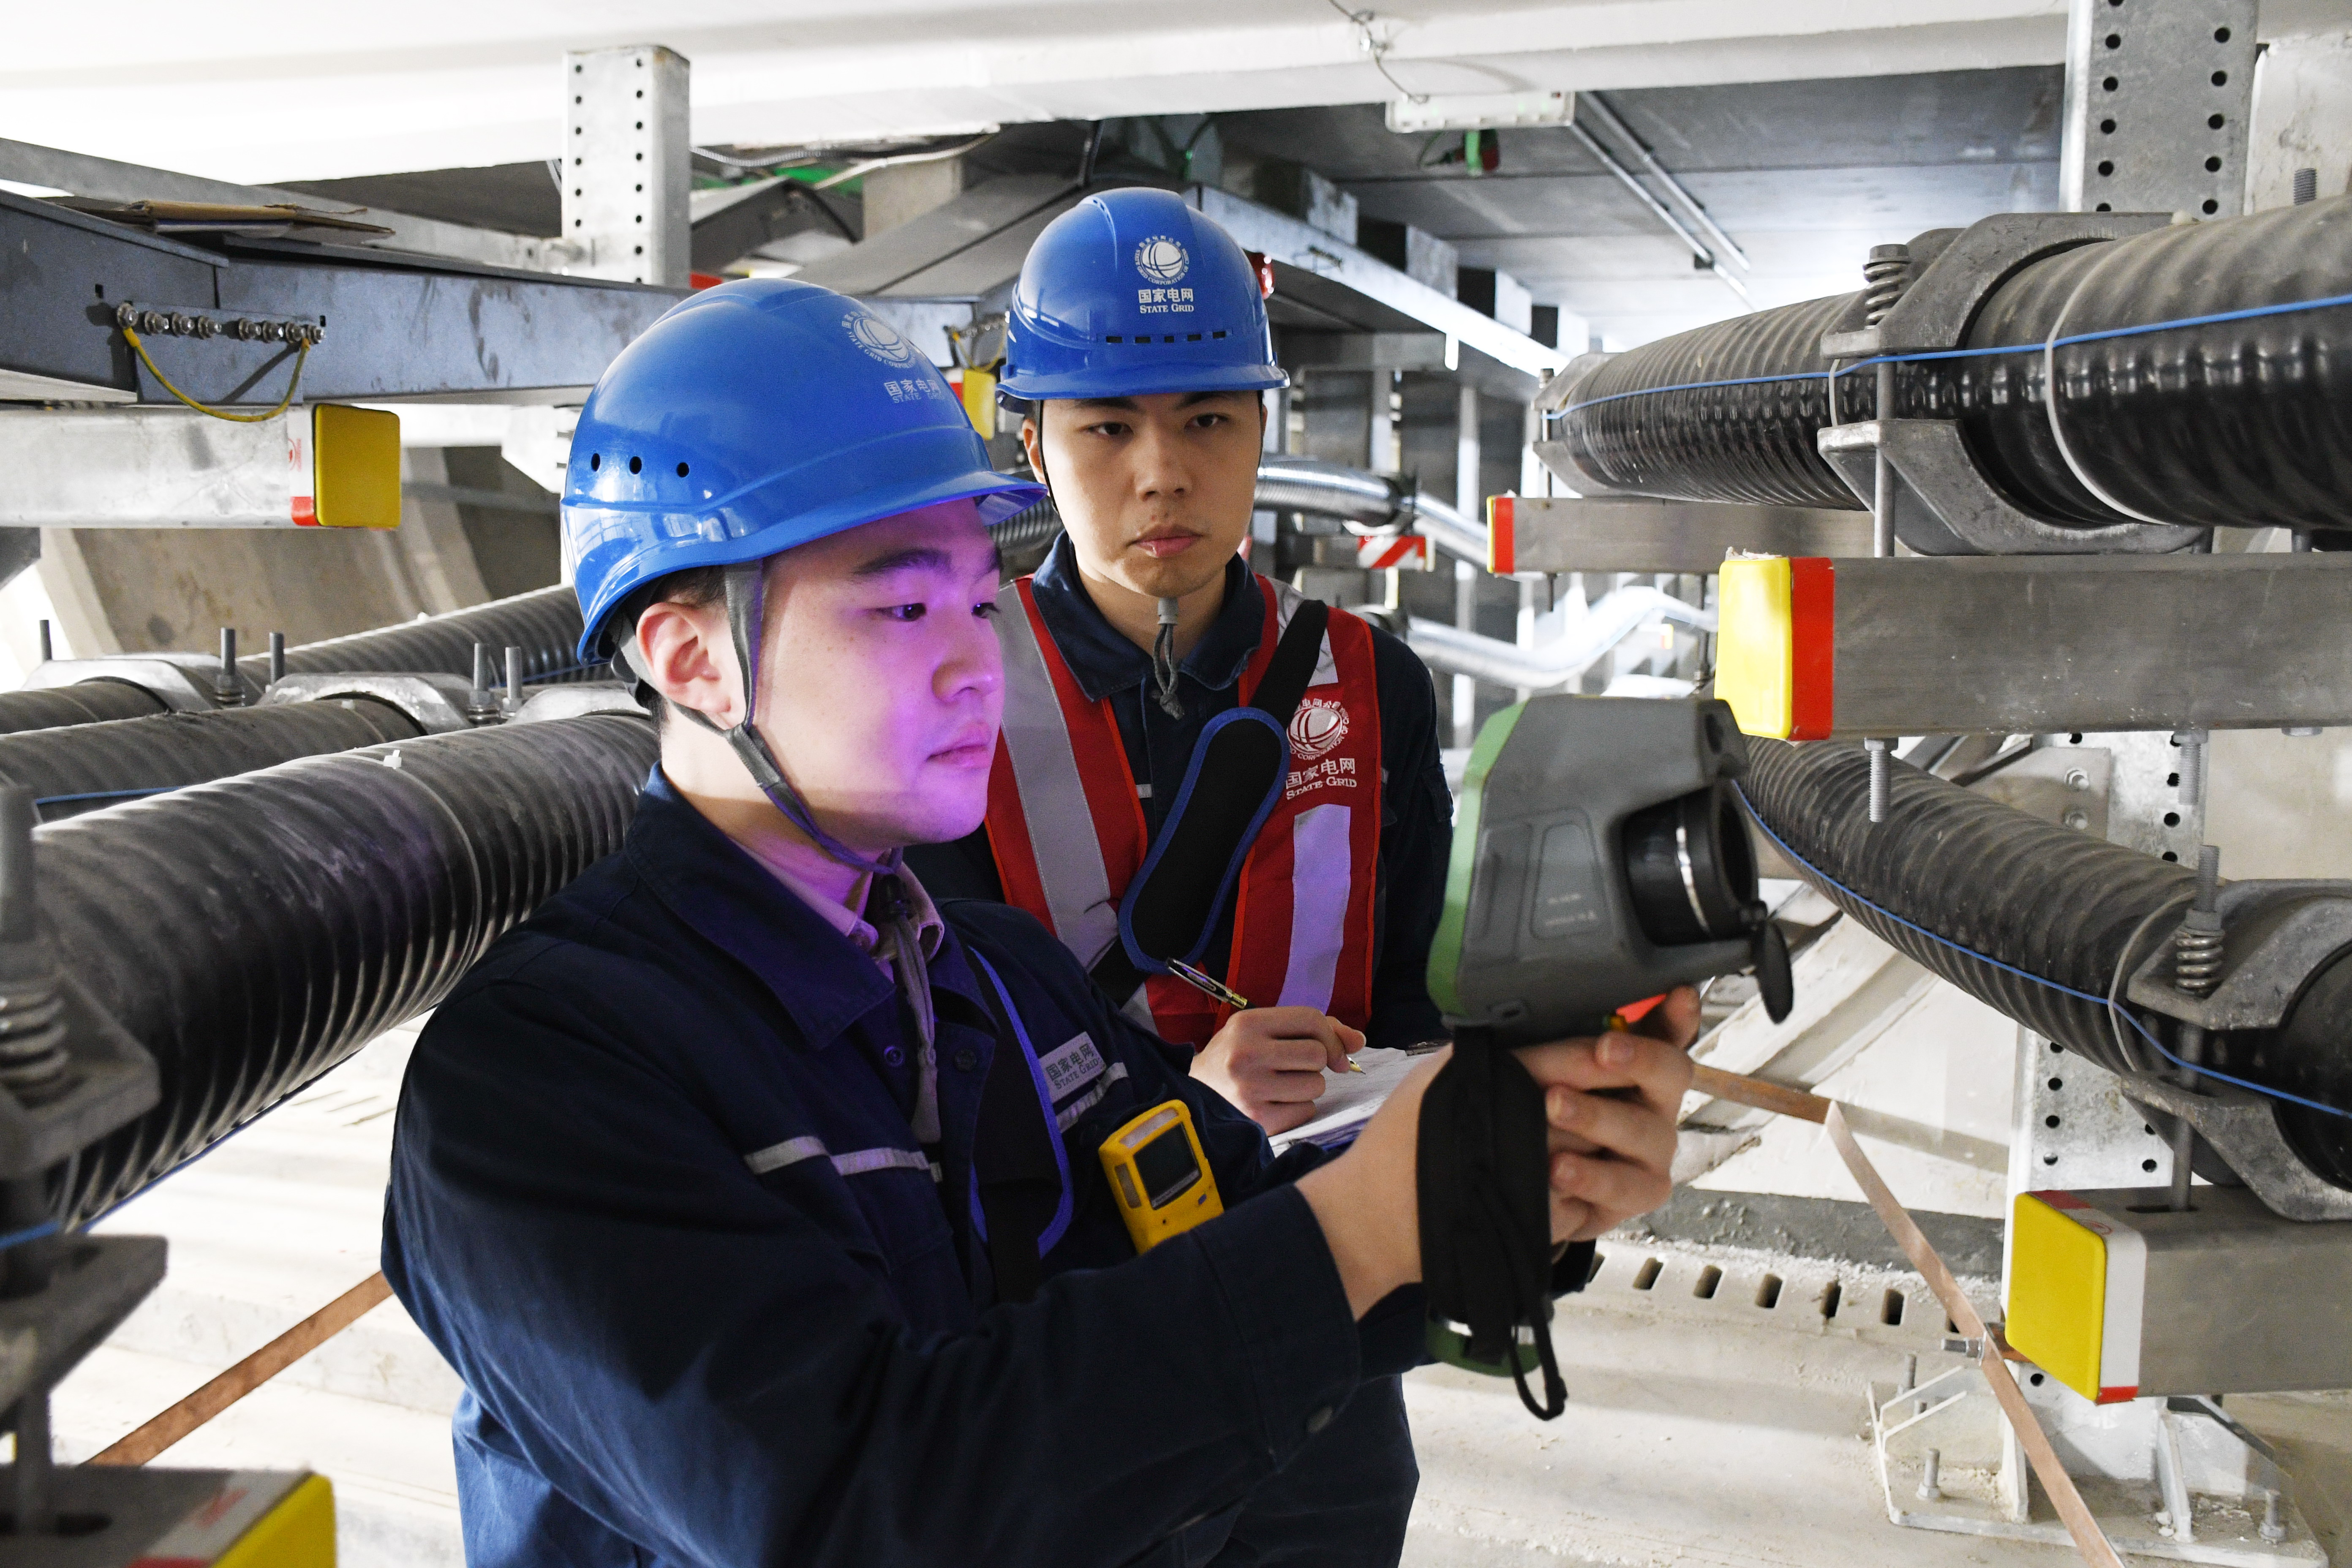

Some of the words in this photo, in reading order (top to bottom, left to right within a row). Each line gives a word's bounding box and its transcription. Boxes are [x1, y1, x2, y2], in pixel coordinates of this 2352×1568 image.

[1138, 287, 1194, 304] 国家电网
[1140, 305, 1168, 314] STATE
[1171, 303, 1194, 313] GRID
[884, 378, 942, 397] 国家电网
[892, 392, 921, 403] STATE
[1286, 758, 1356, 789] 国家电网
[1286, 780, 1323, 800] STATE
[1326, 776, 1357, 788] GRID
[1046, 1043, 1094, 1081] 国家电网
[1054, 1070, 1079, 1089] STATE
[1079, 1058, 1098, 1074] GRID
